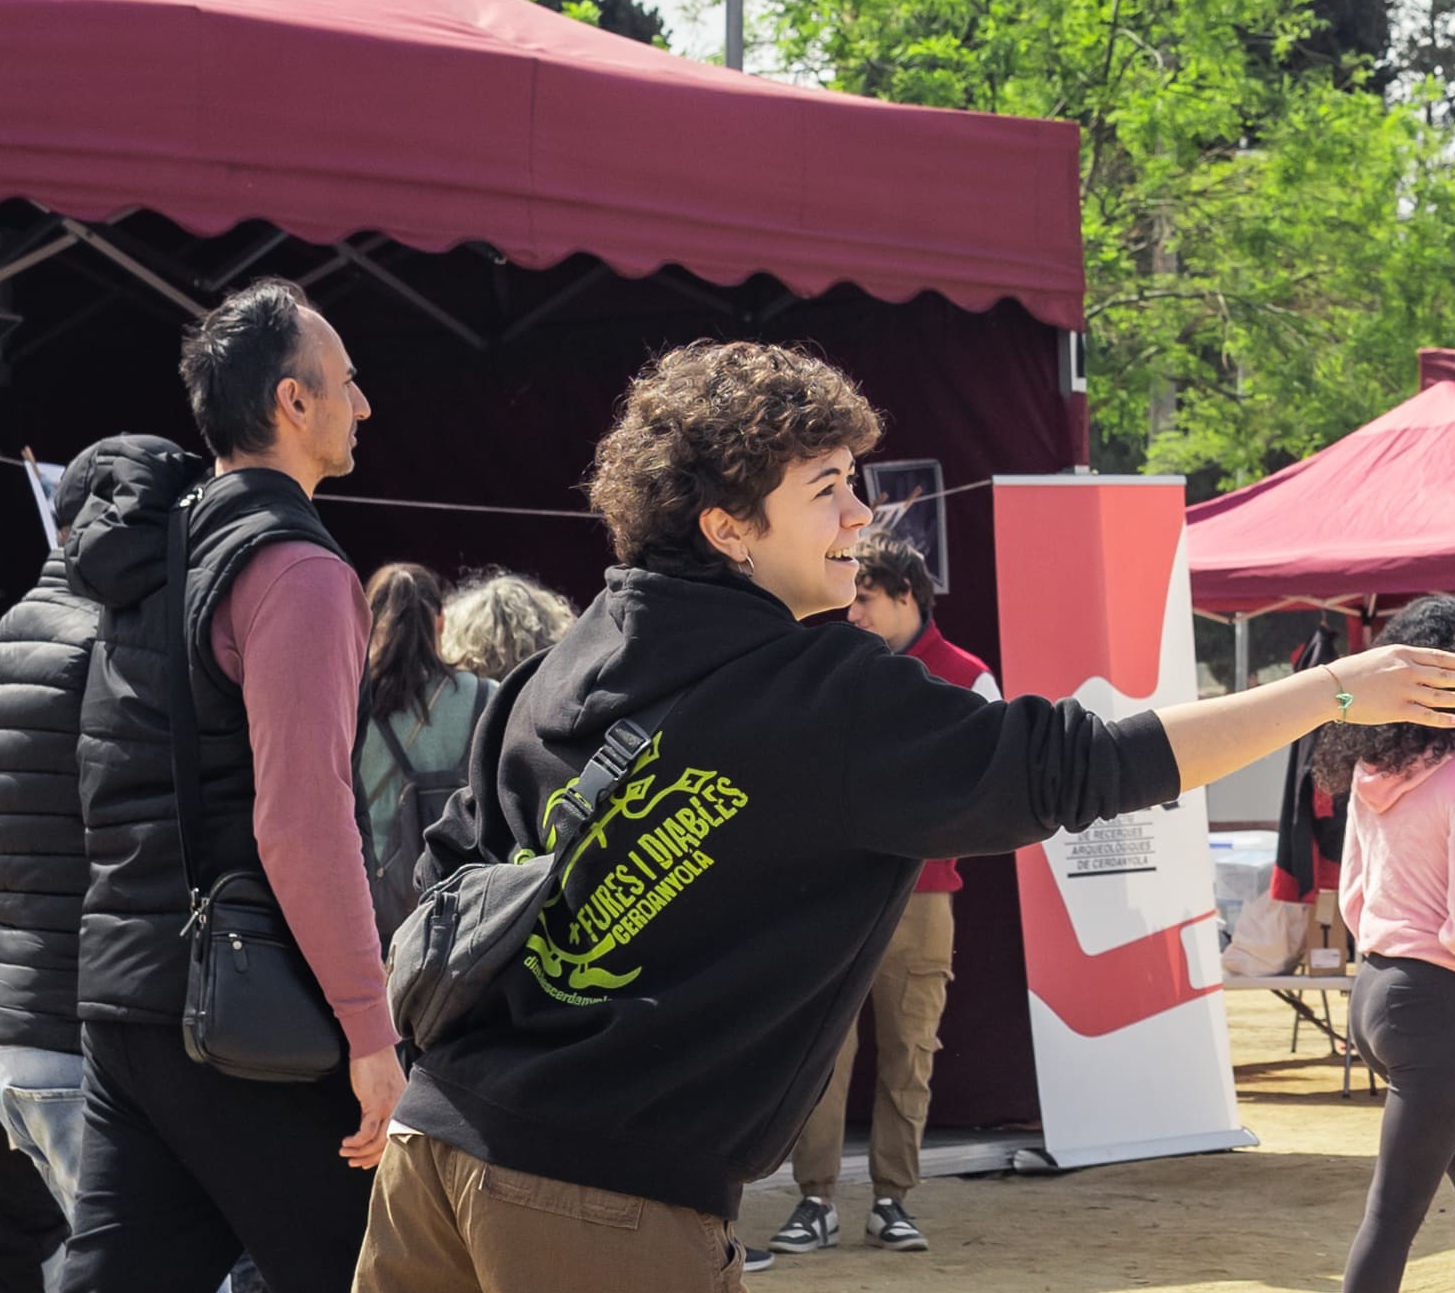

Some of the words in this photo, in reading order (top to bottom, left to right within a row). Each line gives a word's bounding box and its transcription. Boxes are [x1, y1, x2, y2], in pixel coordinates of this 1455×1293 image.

[637, 777, 749, 869] DIABLES
[628, 851, 657, 880] I
[1076, 860, 1089, 870] DE
[1092, 856, 1148, 869] CERDANYOLA
[576, 865, 645, 943] FURES
